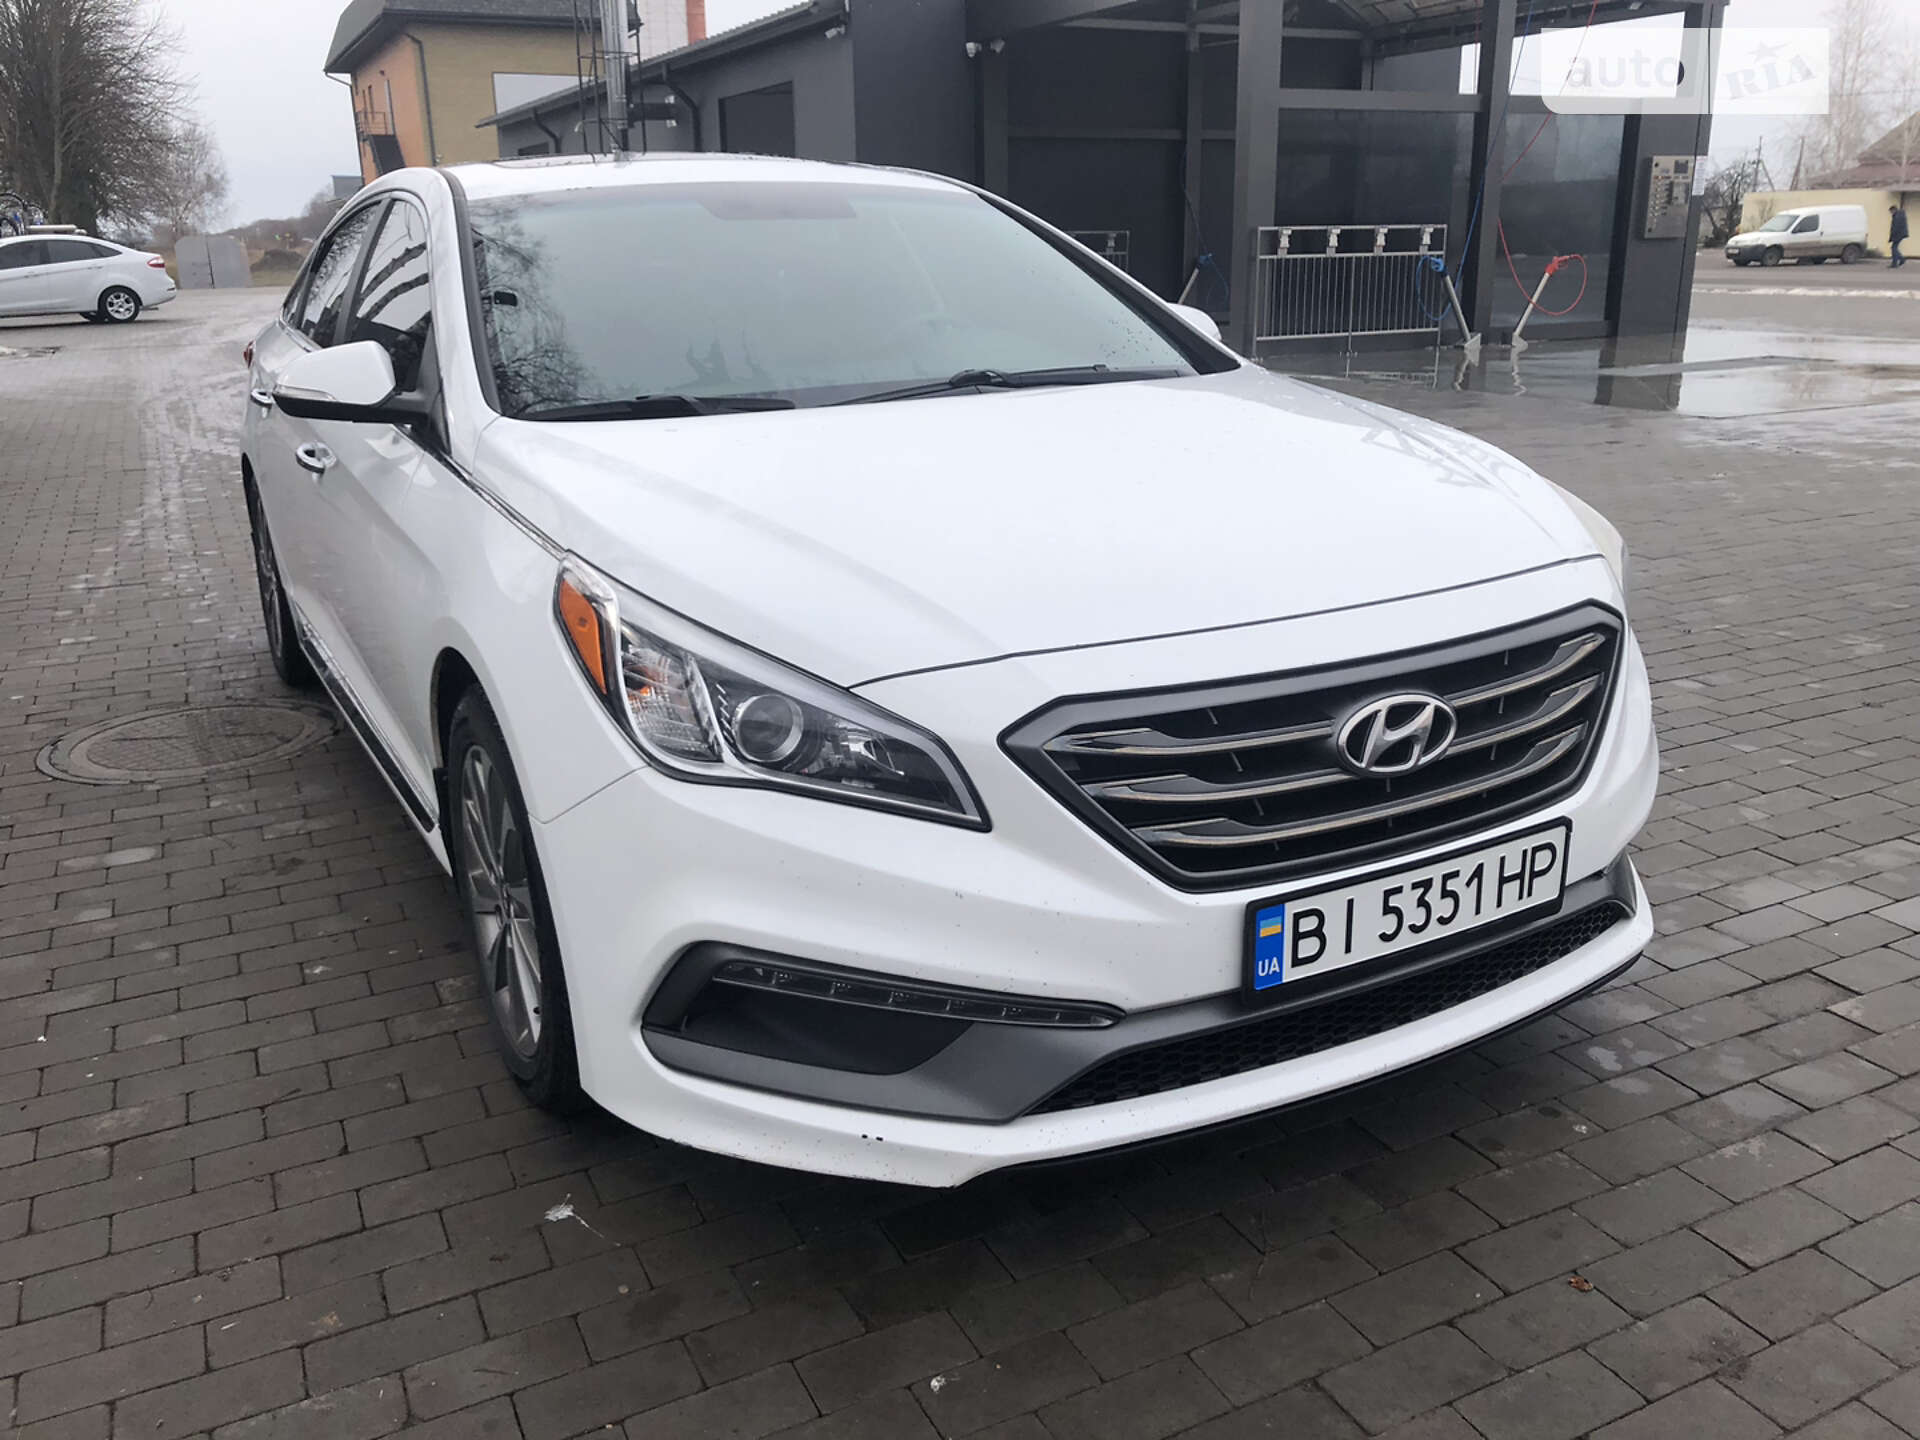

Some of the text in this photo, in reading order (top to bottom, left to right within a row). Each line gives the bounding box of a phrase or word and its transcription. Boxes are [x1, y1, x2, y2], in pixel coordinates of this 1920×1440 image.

[1291, 841, 1557, 968] BI 5351 HP
[1258, 957, 1280, 977] UA
